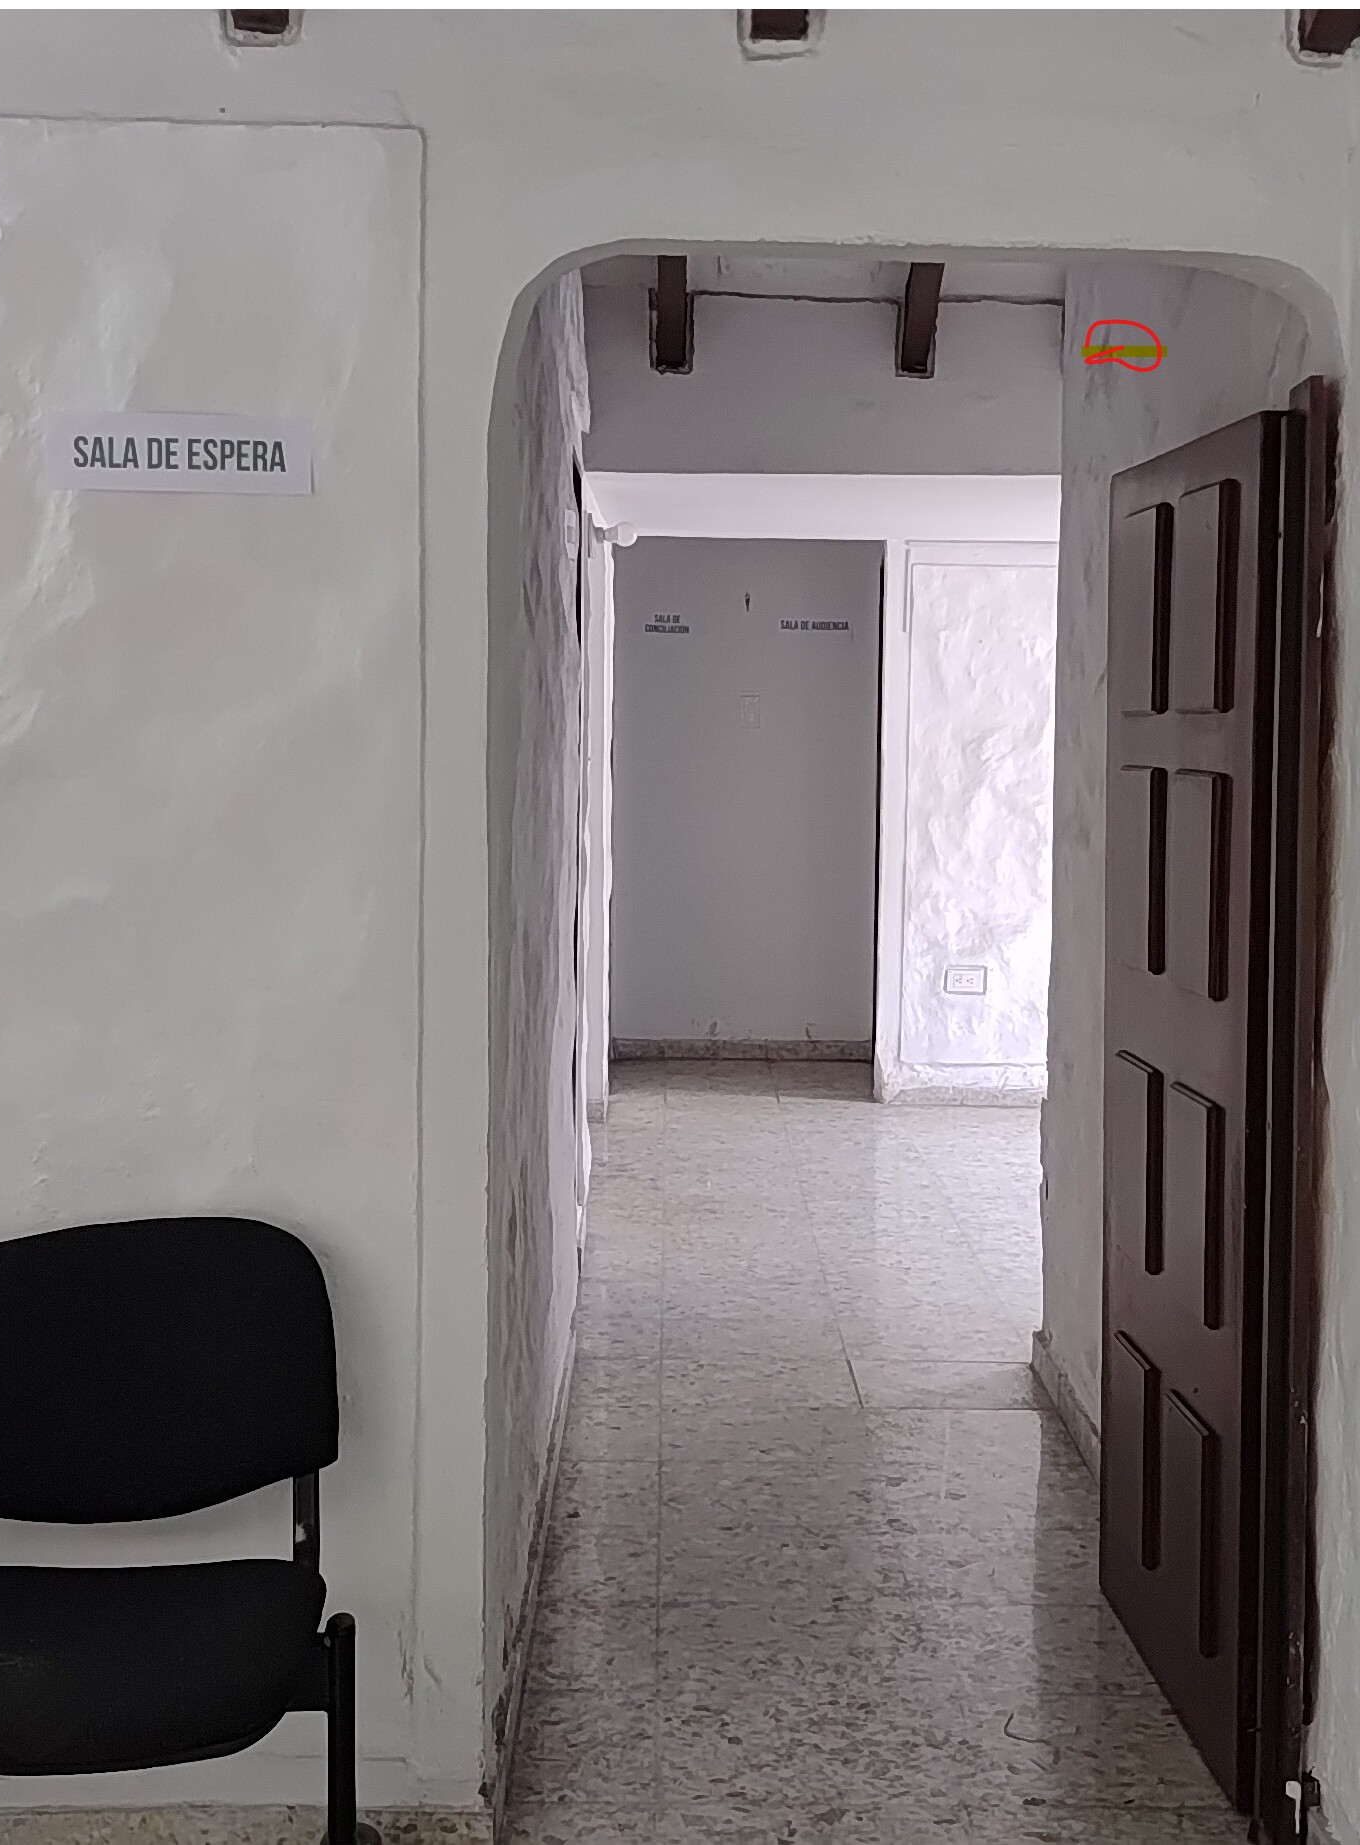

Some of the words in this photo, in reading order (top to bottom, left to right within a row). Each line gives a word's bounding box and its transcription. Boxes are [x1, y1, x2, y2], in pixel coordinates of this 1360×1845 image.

[73, 436, 139, 469] SALA
[147, 438, 179, 469] DE
[187, 438, 286, 472] ESPERA
[654, 614, 671, 623] SALA
[672, 615, 681, 623] DE
[780, 620, 799, 630] SALA
[800, 620, 810, 630] DE
[811, 621, 850, 631] AUDIENCIA
